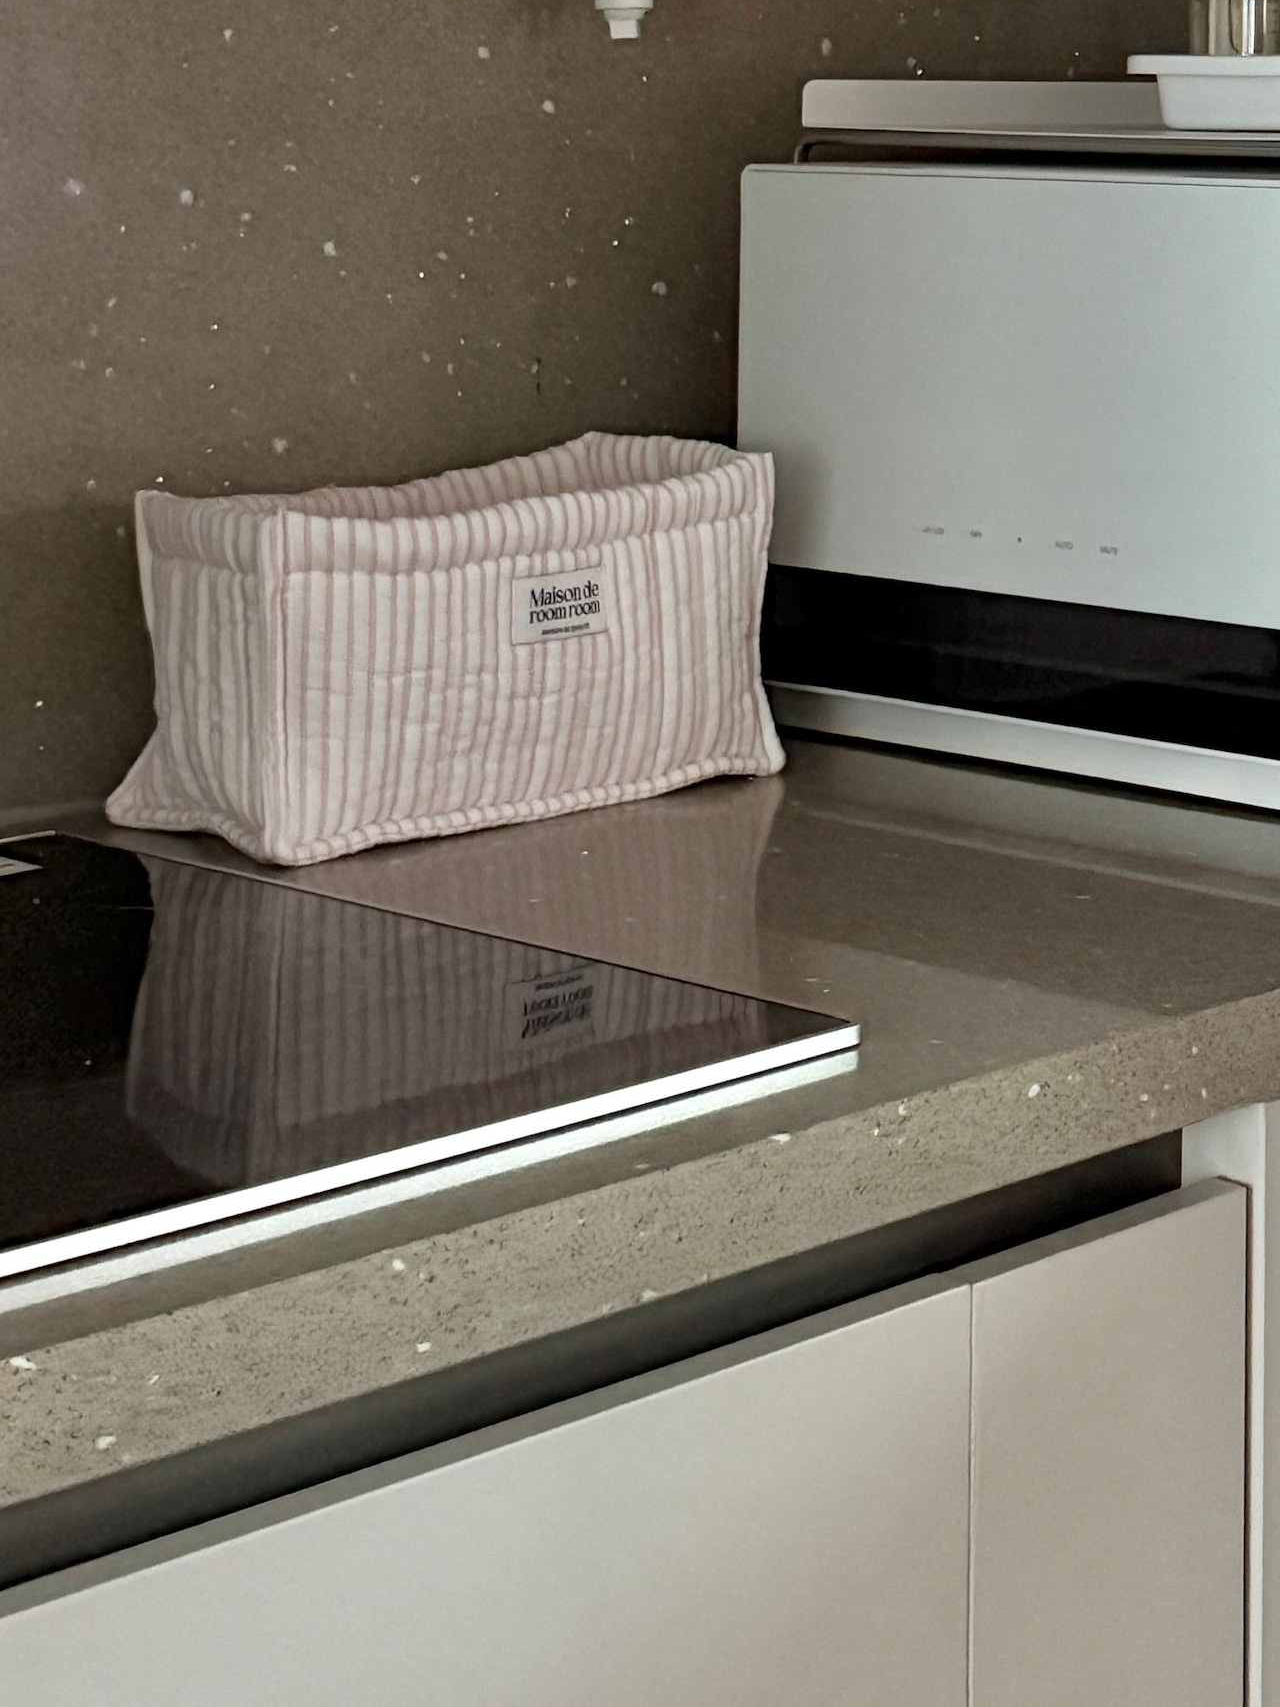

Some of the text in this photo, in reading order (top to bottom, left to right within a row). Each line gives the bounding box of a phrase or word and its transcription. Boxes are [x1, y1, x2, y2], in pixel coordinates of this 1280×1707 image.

[530, 580, 600, 608] Maison de
[529, 600, 601, 624] room room
